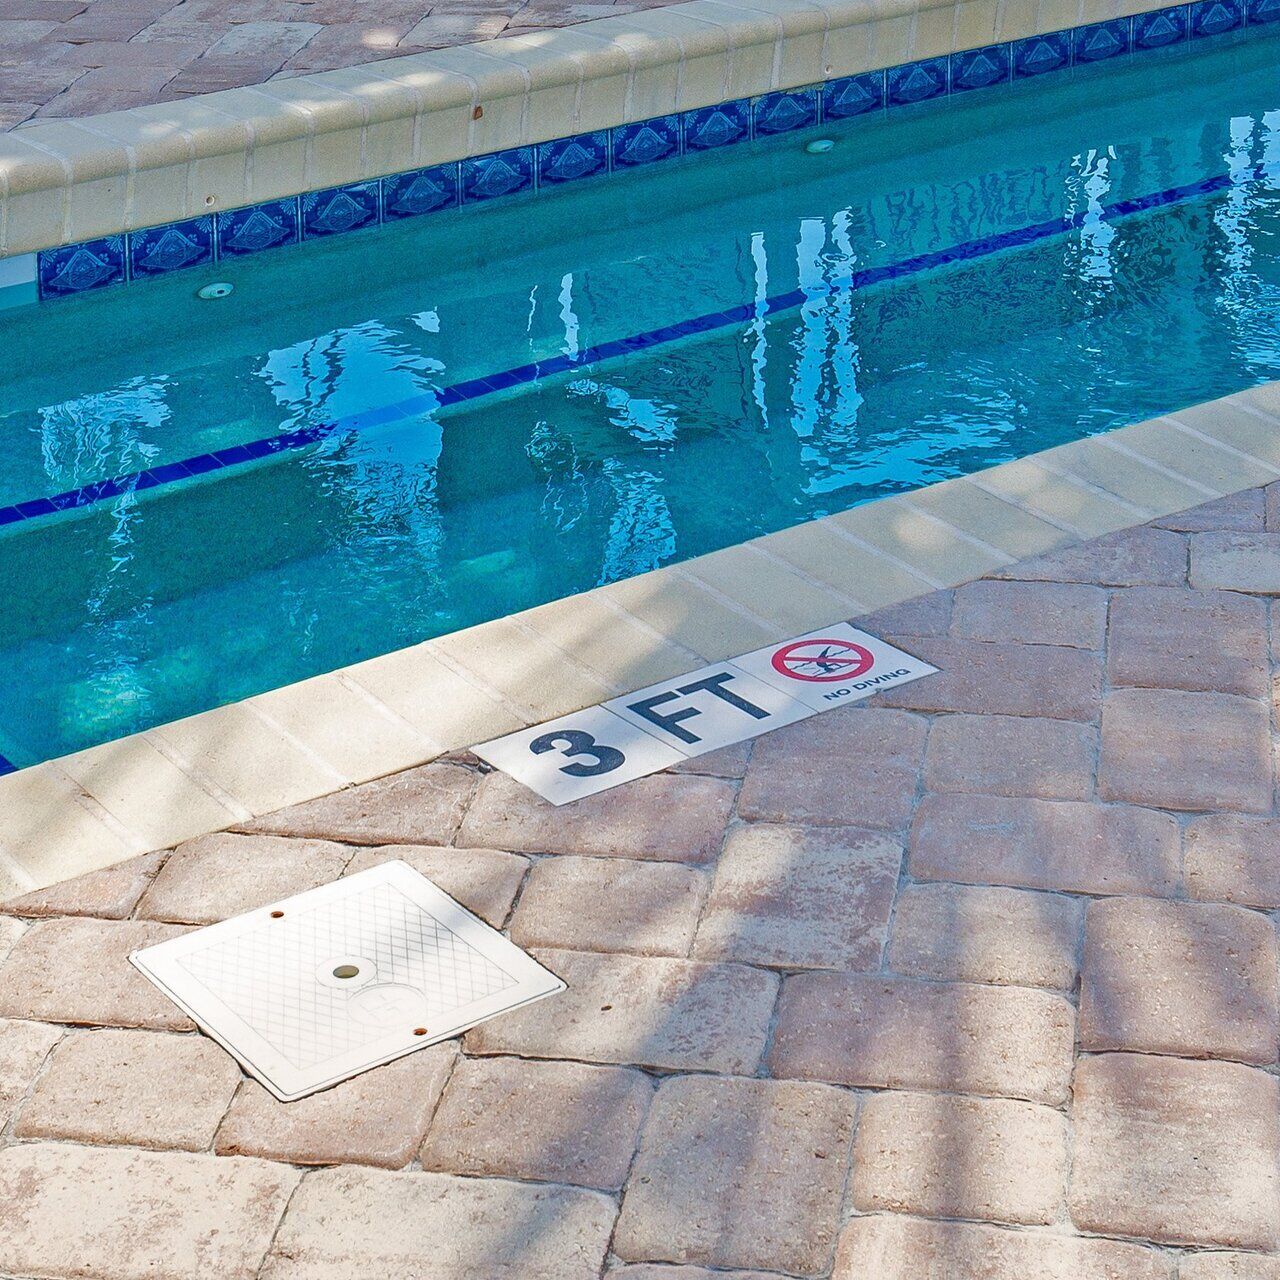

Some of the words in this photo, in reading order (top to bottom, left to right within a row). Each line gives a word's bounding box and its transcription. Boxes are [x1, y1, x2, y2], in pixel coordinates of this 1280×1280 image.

[823, 688, 851, 700] NO
[852, 668, 912, 690] DIVING
[530, 729, 626, 777] 3
[626, 671, 772, 744] FT
